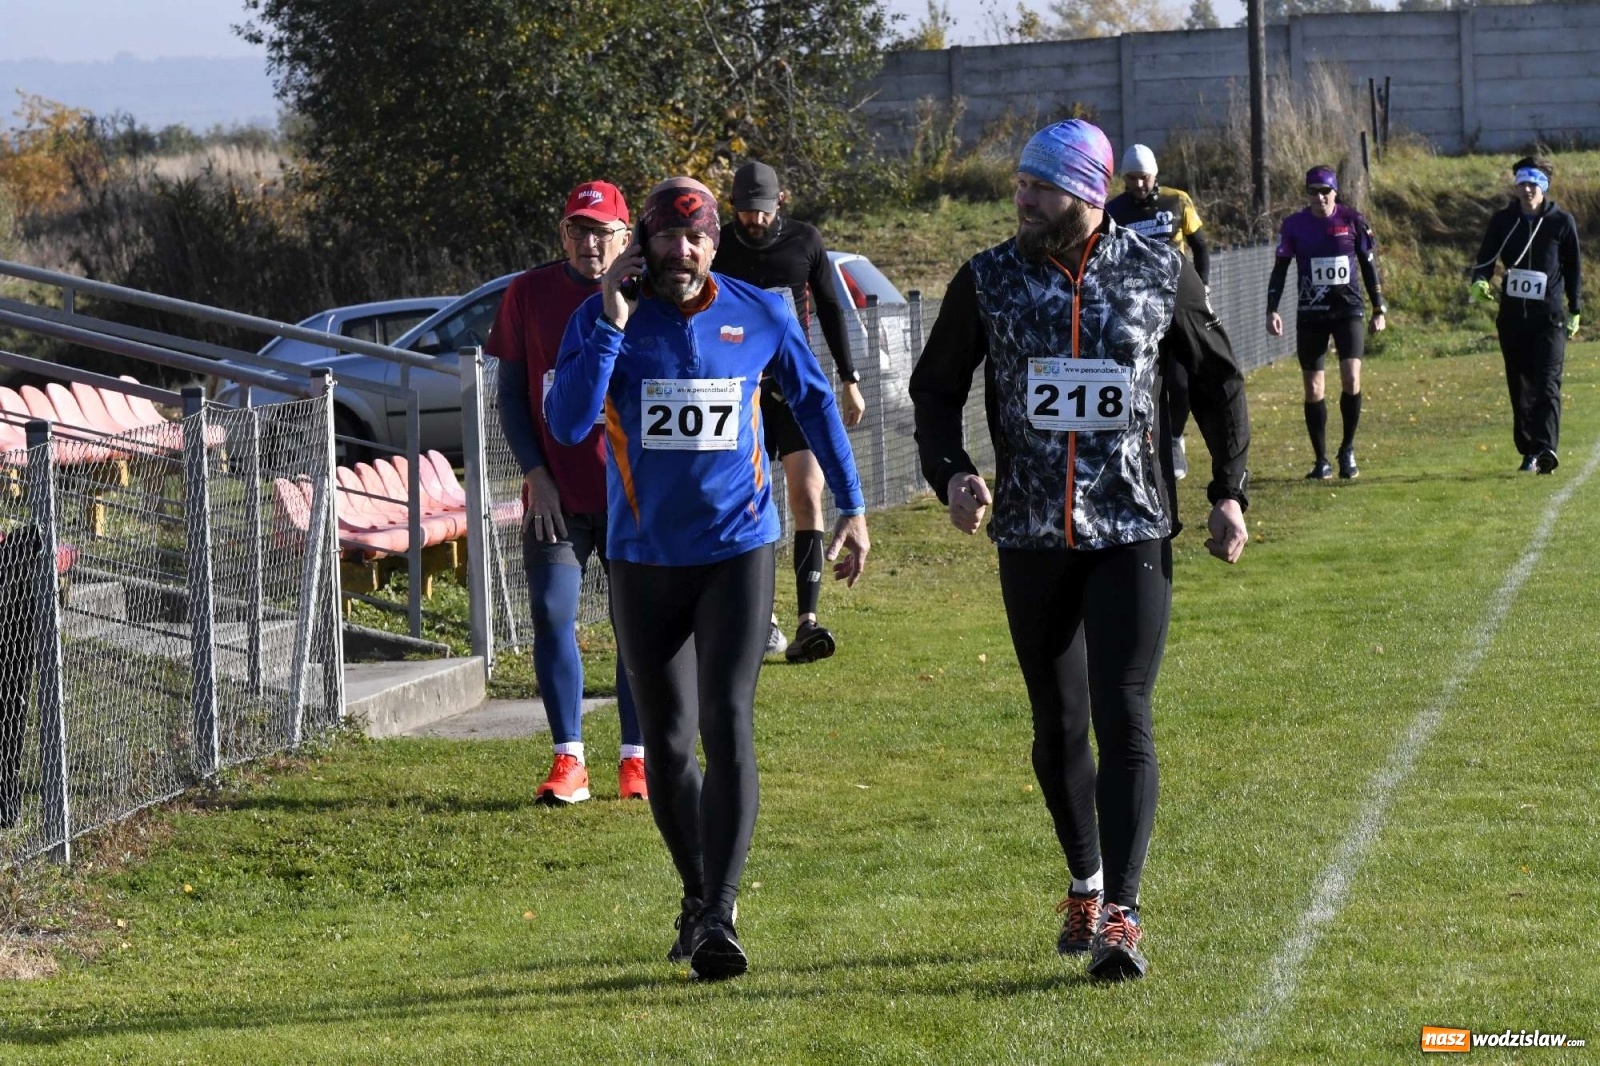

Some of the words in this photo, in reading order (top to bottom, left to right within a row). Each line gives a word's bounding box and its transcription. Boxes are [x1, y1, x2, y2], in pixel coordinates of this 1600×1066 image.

[1314, 267, 1347, 280] 100
[1510, 279, 1542, 294] 101
[1034, 384, 1123, 418] 218
[647, 404, 733, 437] 207
